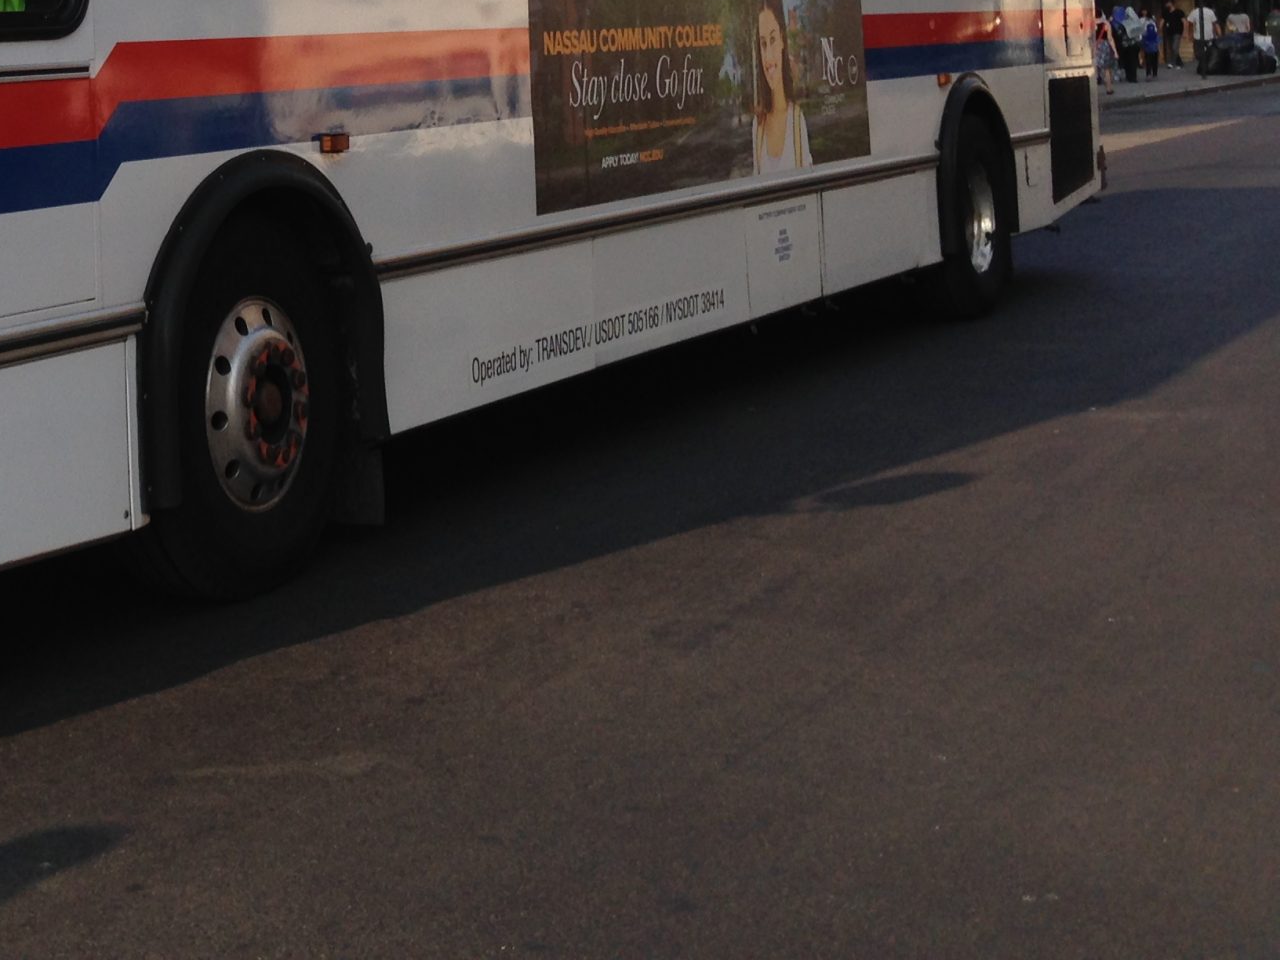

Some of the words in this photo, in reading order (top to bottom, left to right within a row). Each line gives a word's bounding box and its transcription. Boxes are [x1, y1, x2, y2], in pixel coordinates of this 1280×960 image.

[543, 29, 597, 56] NASSAU
[599, 26, 673, 53] COMMUNITY
[676, 24, 724, 48] COLLEGE
[569, 60, 608, 120] Stay
[611, 58, 651, 104] close.
[656, 55, 678, 98] Go
[677, 53, 704, 110] far.
[602, 154, 619, 169] APPLY
[472, 346, 517, 385] Operated
[520, 342, 534, 373] by:
[594, 314, 626, 345] USDOT
[628, 305, 659, 335] 505166
[665, 294, 699, 322] NYSDOT
[701, 288, 725, 314] 38414
